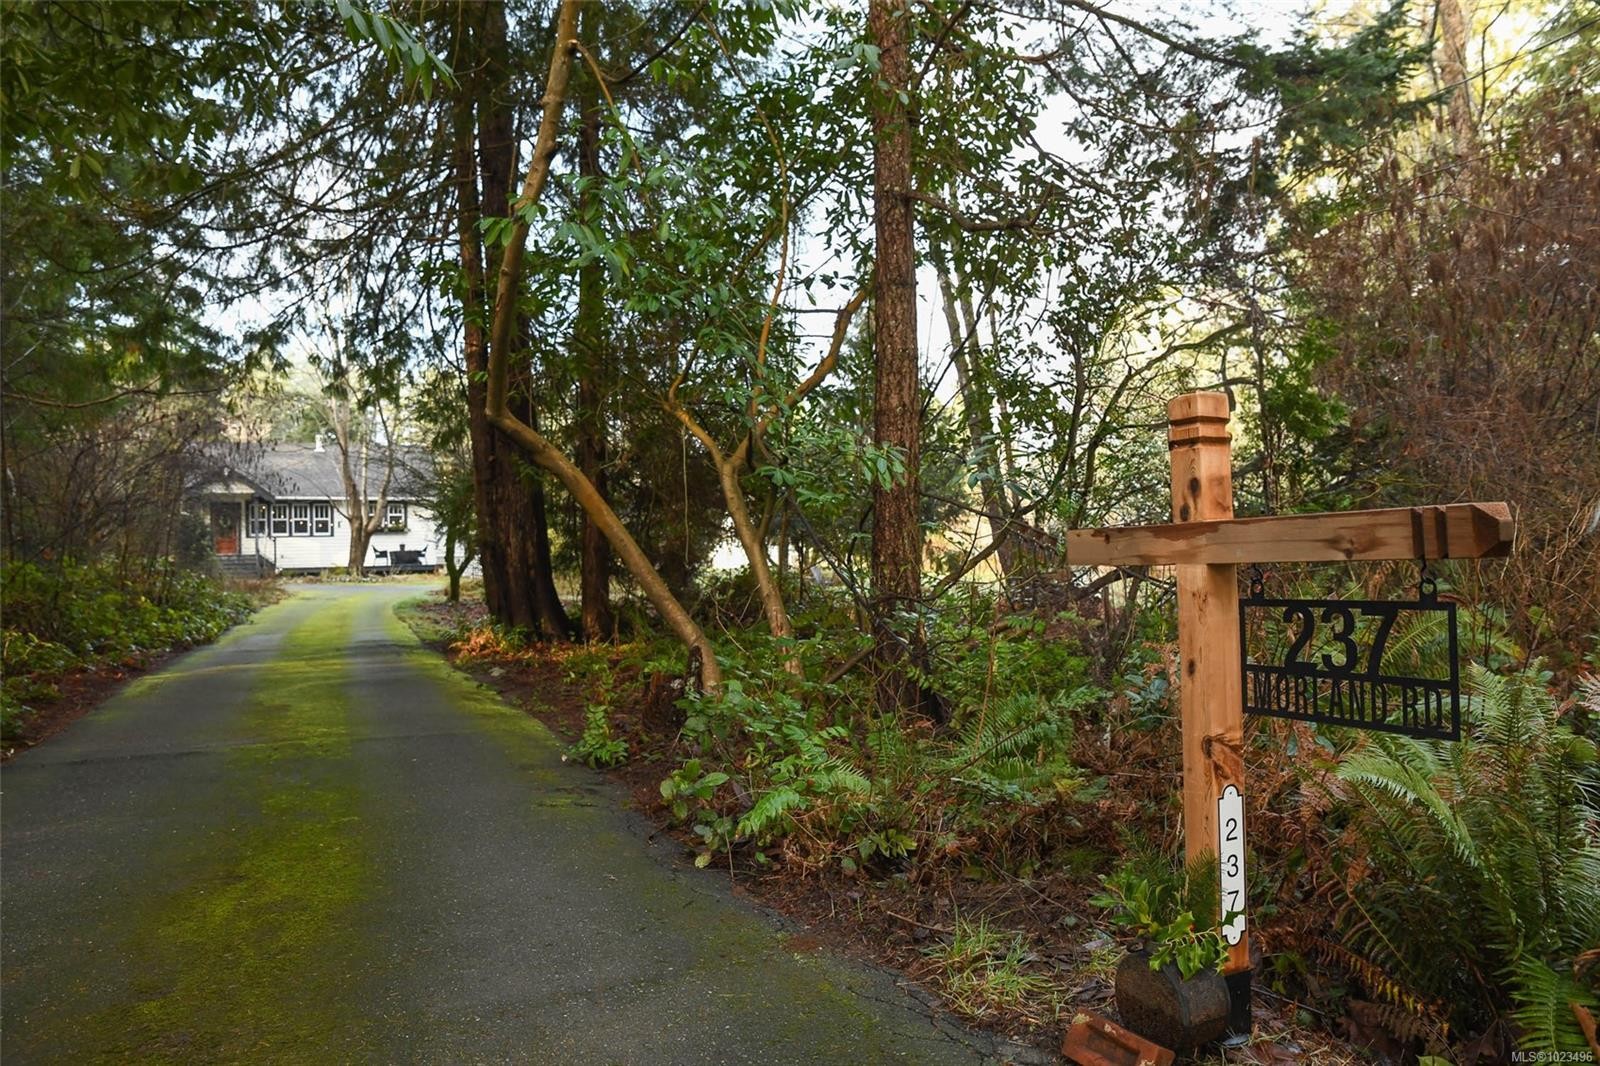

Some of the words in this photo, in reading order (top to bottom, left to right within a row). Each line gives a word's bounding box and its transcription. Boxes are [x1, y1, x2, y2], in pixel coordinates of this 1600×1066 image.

[1283, 605, 1398, 677] 237
[1254, 671, 1387, 723] MORLAND
[1402, 685, 1443, 730] RD
[1225, 817, 1239, 911] 237
